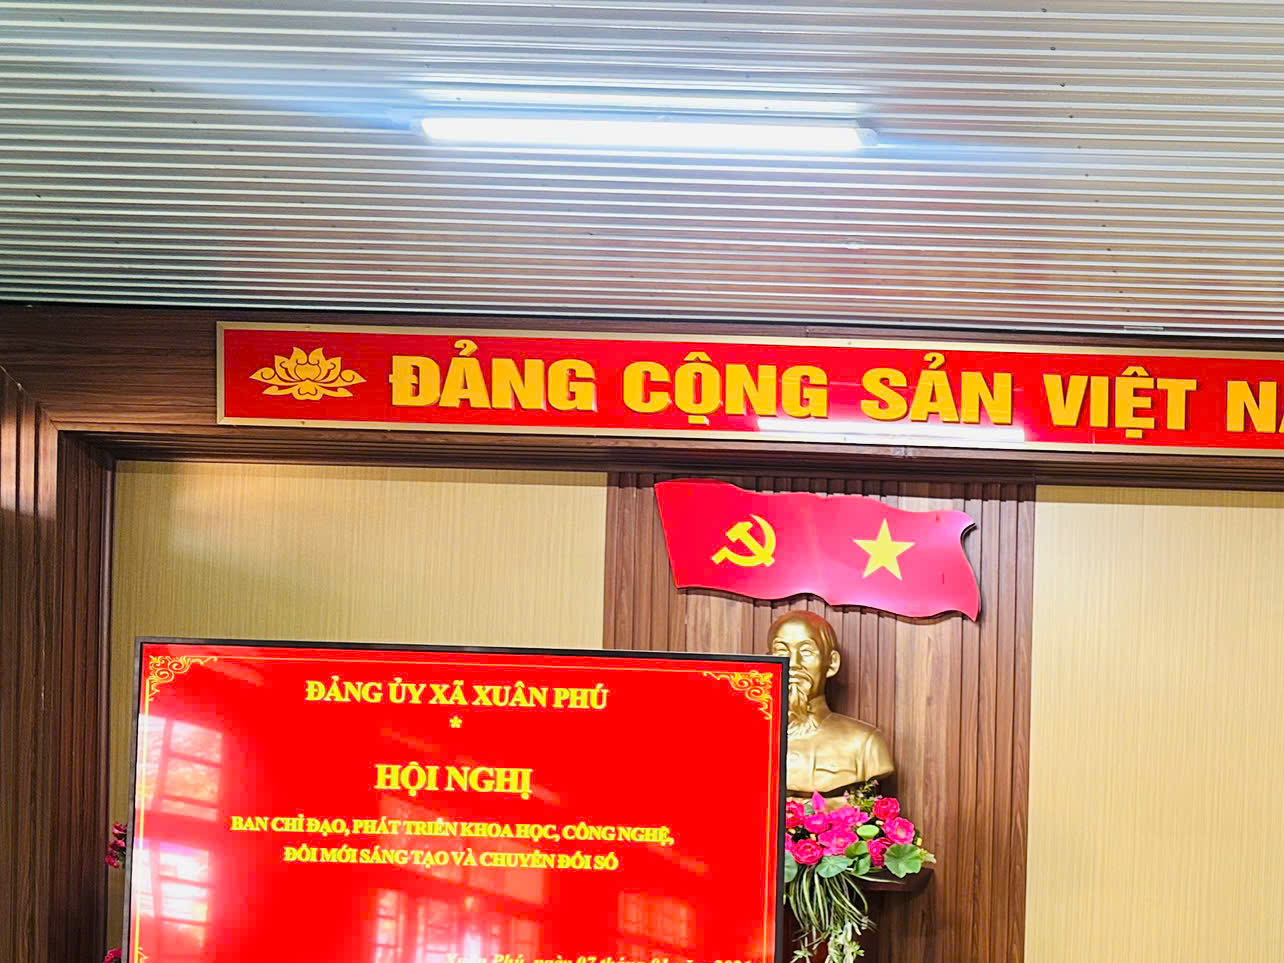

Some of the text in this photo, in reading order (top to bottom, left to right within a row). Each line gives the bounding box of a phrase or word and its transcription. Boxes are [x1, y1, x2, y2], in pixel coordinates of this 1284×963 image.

[388, 338, 595, 411] ĐẢNG
[624, 352, 827, 424] CỘNG
[861, 351, 1012, 423] SẢN
[1044, 367, 1196, 438] VIỆT
[306, 676, 608, 709] ĐẢNG ỦY XÃ XUÂN PHÚ
[375, 762, 532, 799] HỘI NGHỊ
[230, 815, 270, 832] BAN
[270, 812, 305, 833] CHỈ
[306, 815, 350, 836] ĐẠO,
[351, 815, 401, 835] PHÁT
[459, 820, 514, 838] KHOA
[514, 822, 561, 843] HỌC,
[561, 820, 616, 842] CÔNG
[616, 824, 676, 848] NGHỆ,
[319, 842, 359, 864] MỚI
[358, 844, 409, 865] SÁNG
[409, 849, 450, 869] TẠO
[450, 846, 479, 867] VÀ
